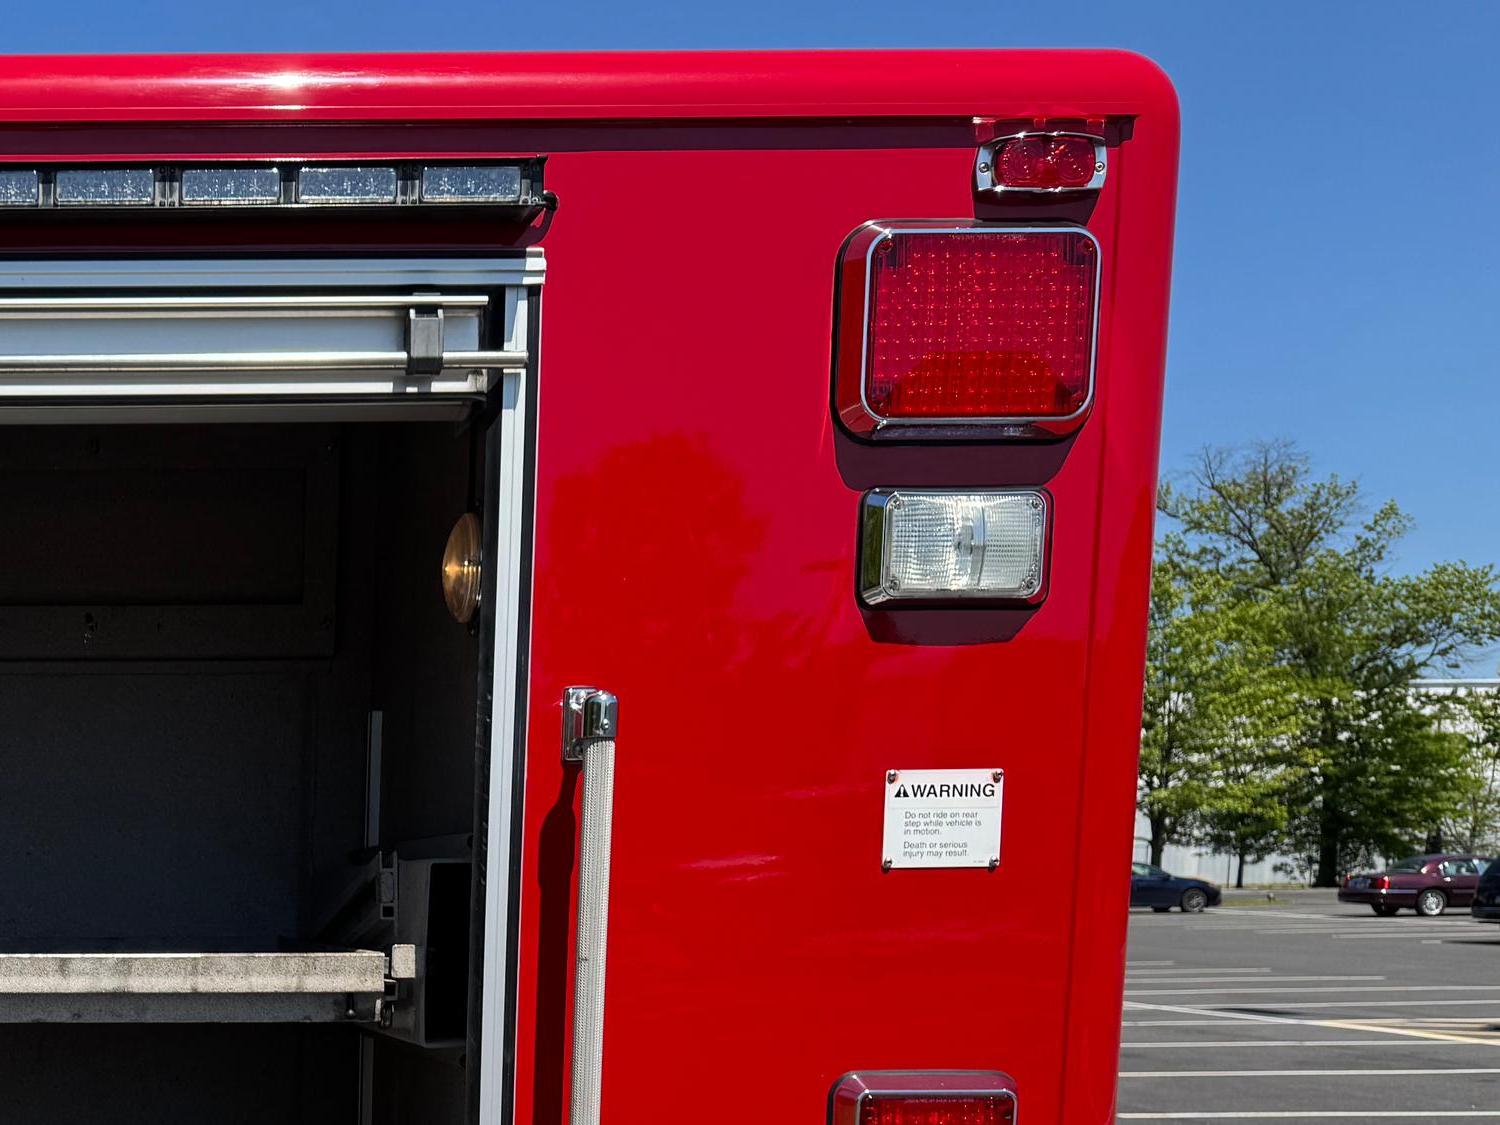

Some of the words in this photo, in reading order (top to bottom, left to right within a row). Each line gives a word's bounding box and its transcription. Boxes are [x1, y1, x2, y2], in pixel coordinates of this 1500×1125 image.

[911, 783, 995, 798] WARNING
[904, 811, 916, 819] Do
[918, 811, 931, 819] not
[933, 811, 948, 819] ride
[904, 820, 921, 828] step
[946, 819, 973, 827] vehicle
[903, 841, 927, 849] Death
[939, 841, 968, 849] serious
[903, 850, 925, 859] injury
[926, 850, 943, 859] may
